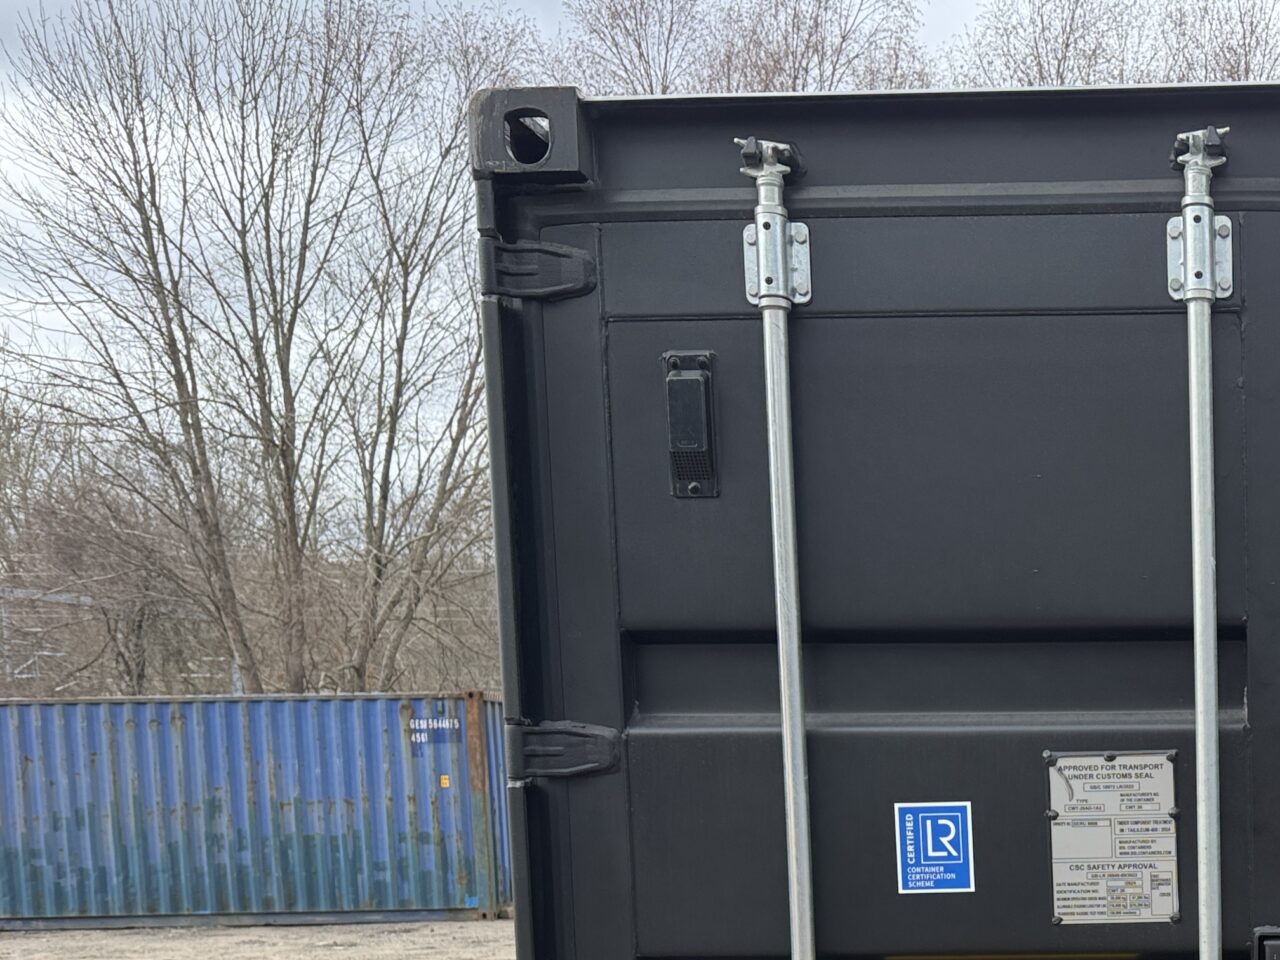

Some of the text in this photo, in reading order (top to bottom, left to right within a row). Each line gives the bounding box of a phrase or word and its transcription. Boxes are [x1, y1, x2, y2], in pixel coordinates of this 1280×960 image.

[1058, 764, 1098, 772] APPROVED
[1118, 763, 1164, 771] TRANSPORT
[1095, 772, 1133, 780] CUSTOMS
[905, 813, 916, 864] CERTIFIED
[926, 819, 959, 857] LR
[908, 880, 935, 888] SCHEME
